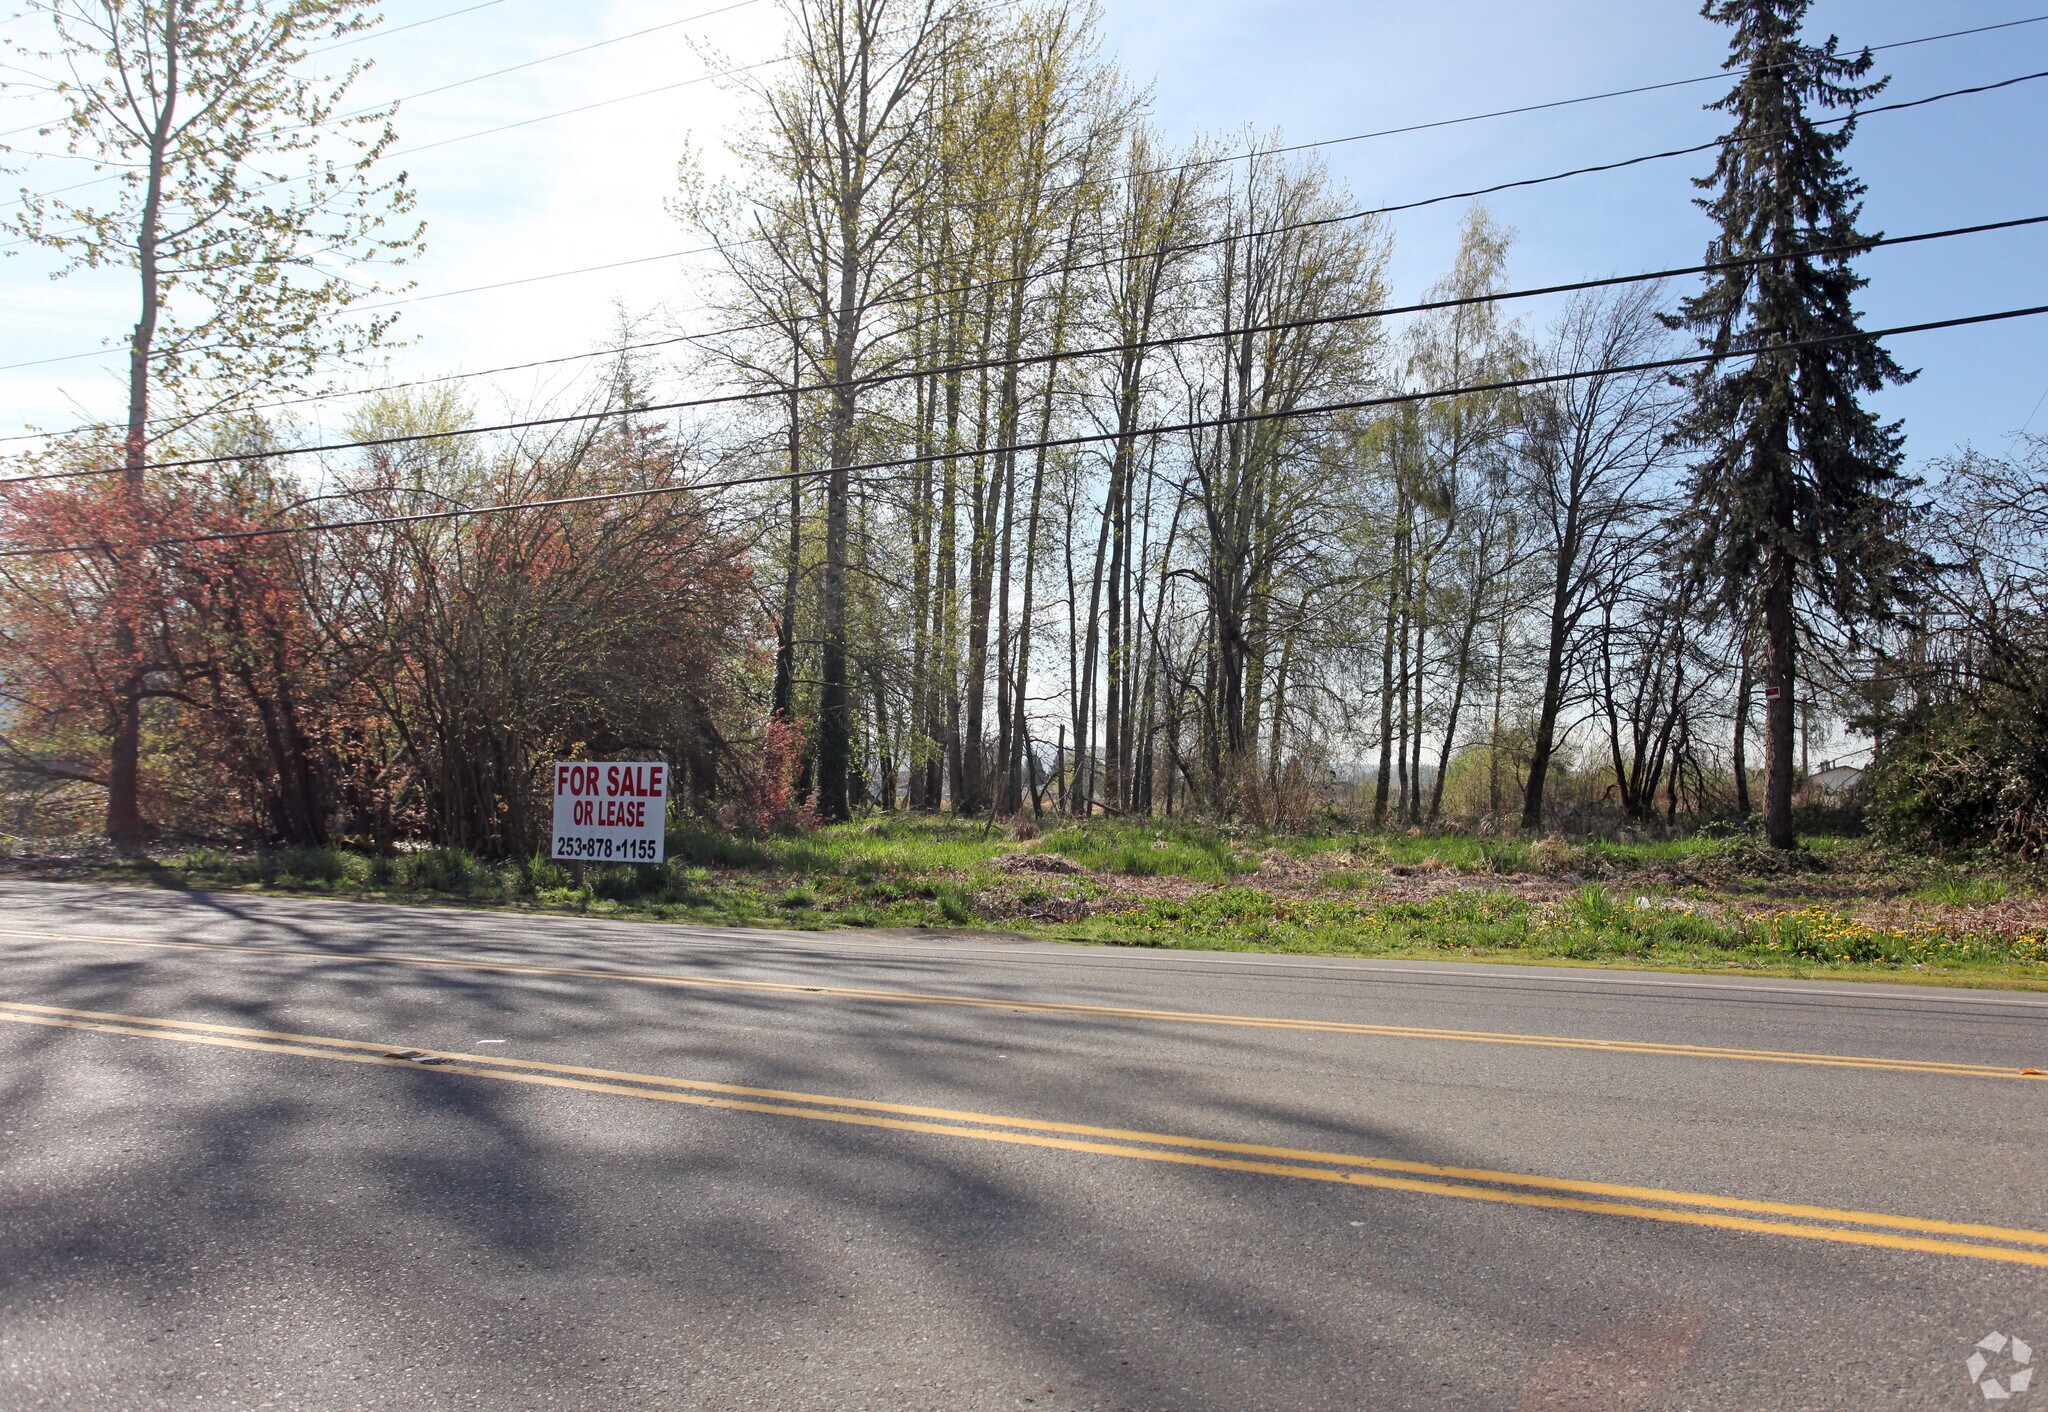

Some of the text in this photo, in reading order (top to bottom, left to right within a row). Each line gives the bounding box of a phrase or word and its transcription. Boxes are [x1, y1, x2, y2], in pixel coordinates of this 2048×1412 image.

[558, 766, 663, 797] FOR SALE
[573, 800, 645, 827] OR LEASE
